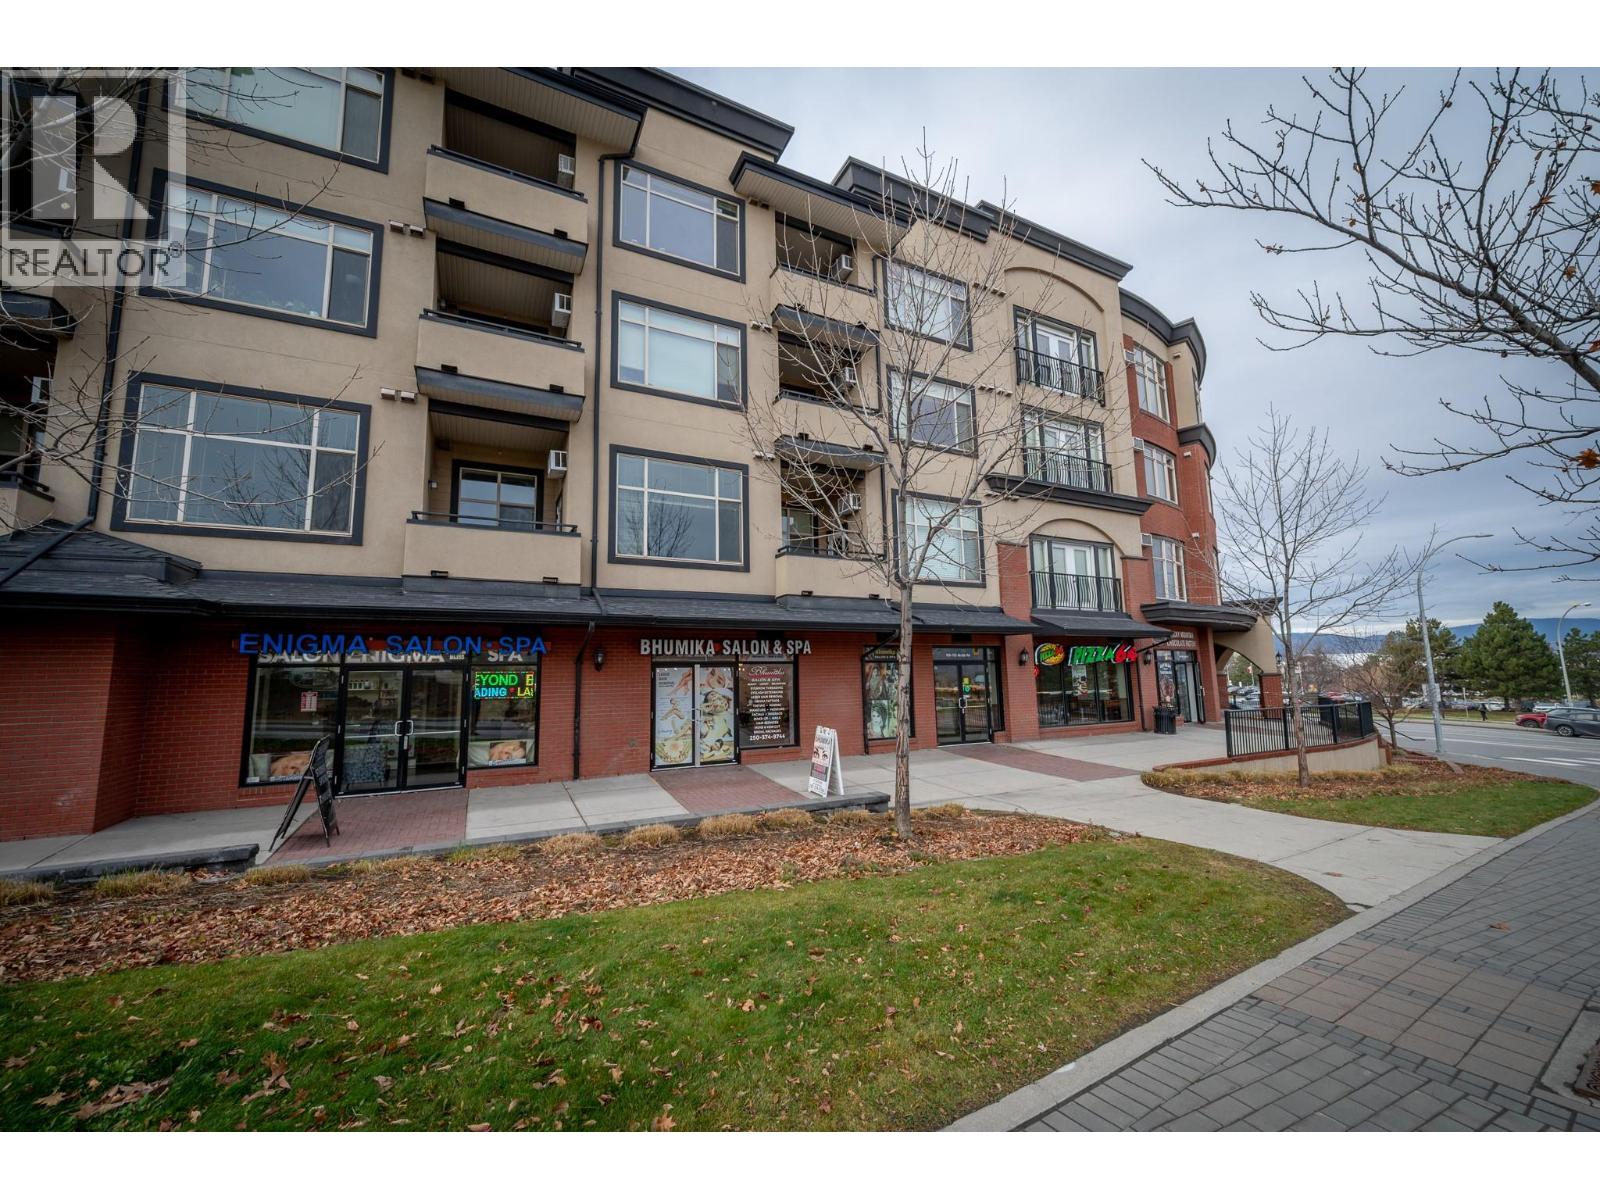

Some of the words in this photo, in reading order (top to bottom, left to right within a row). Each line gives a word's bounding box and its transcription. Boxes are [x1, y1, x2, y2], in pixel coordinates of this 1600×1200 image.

[239, 633, 368, 655] ENIGMA
[386, 635, 482, 655] SALON
[500, 636, 547, 655] SPA
[640, 639, 716, 655] BHUMIKA
[722, 639, 769, 655] SALON
[773, 640, 783, 655] &
[786, 640, 812, 655] SPA
